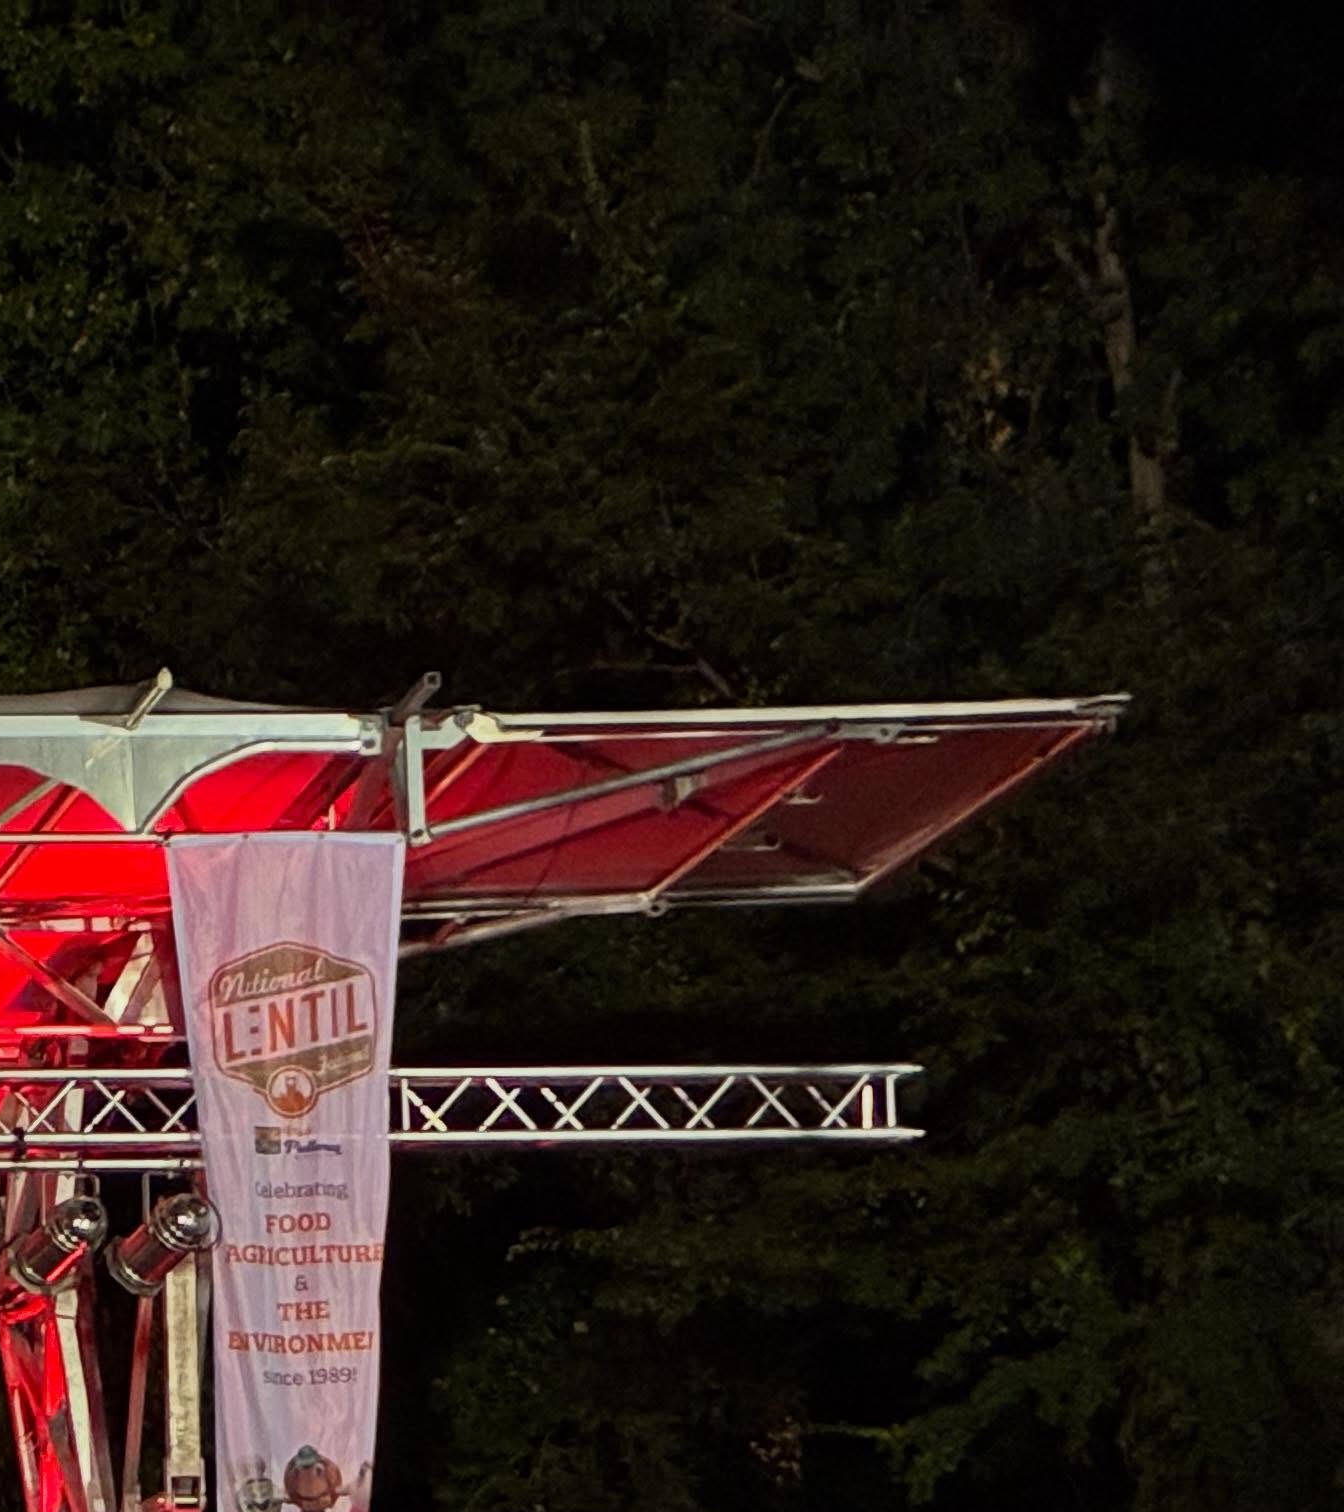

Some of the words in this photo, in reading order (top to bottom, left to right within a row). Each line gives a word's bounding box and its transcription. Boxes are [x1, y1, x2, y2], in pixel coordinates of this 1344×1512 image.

[219, 957, 326, 1001] National
[264, 1212, 332, 1234] FOOD
[294, 1274, 309, 1291] &
[277, 1301, 330, 1322] THE
